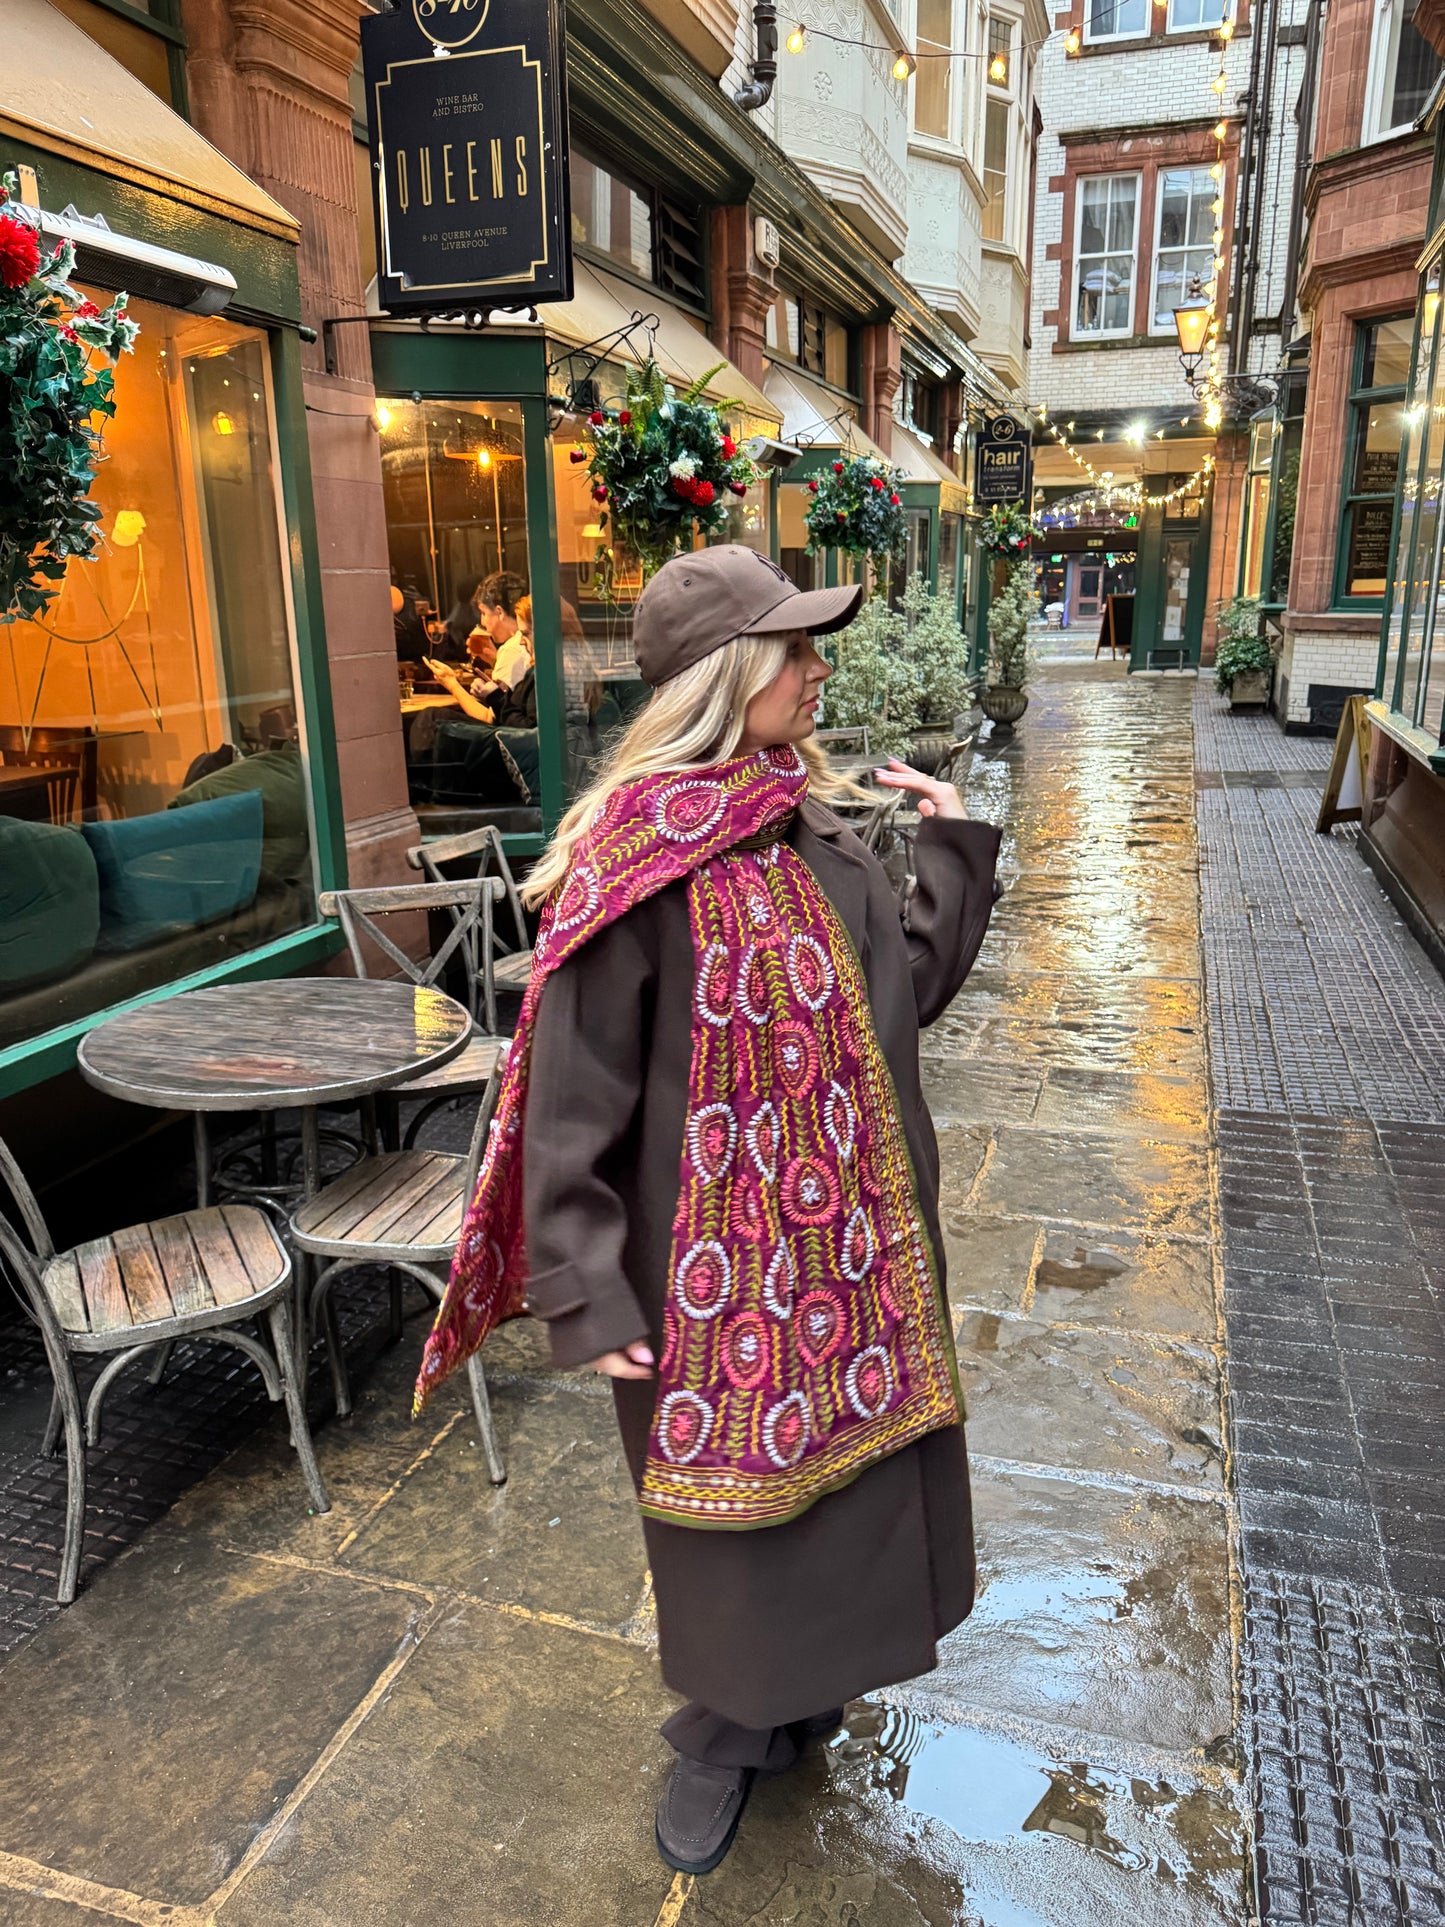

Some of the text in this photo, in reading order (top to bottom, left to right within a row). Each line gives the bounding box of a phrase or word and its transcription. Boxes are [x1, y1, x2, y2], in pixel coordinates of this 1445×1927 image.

[436, 93, 479, 106] WINE BAR
[432, 102, 484, 117] AND BISTRO
[397, 135, 528, 215] QUEENS
[441, 230, 471, 241] QUEEN
[473, 226, 508, 238] AVENUE
[441, 239, 489, 251] LIVERPOOL
[995, 424, 1012, 435] 2-6
[984, 449, 1021, 466] hair
